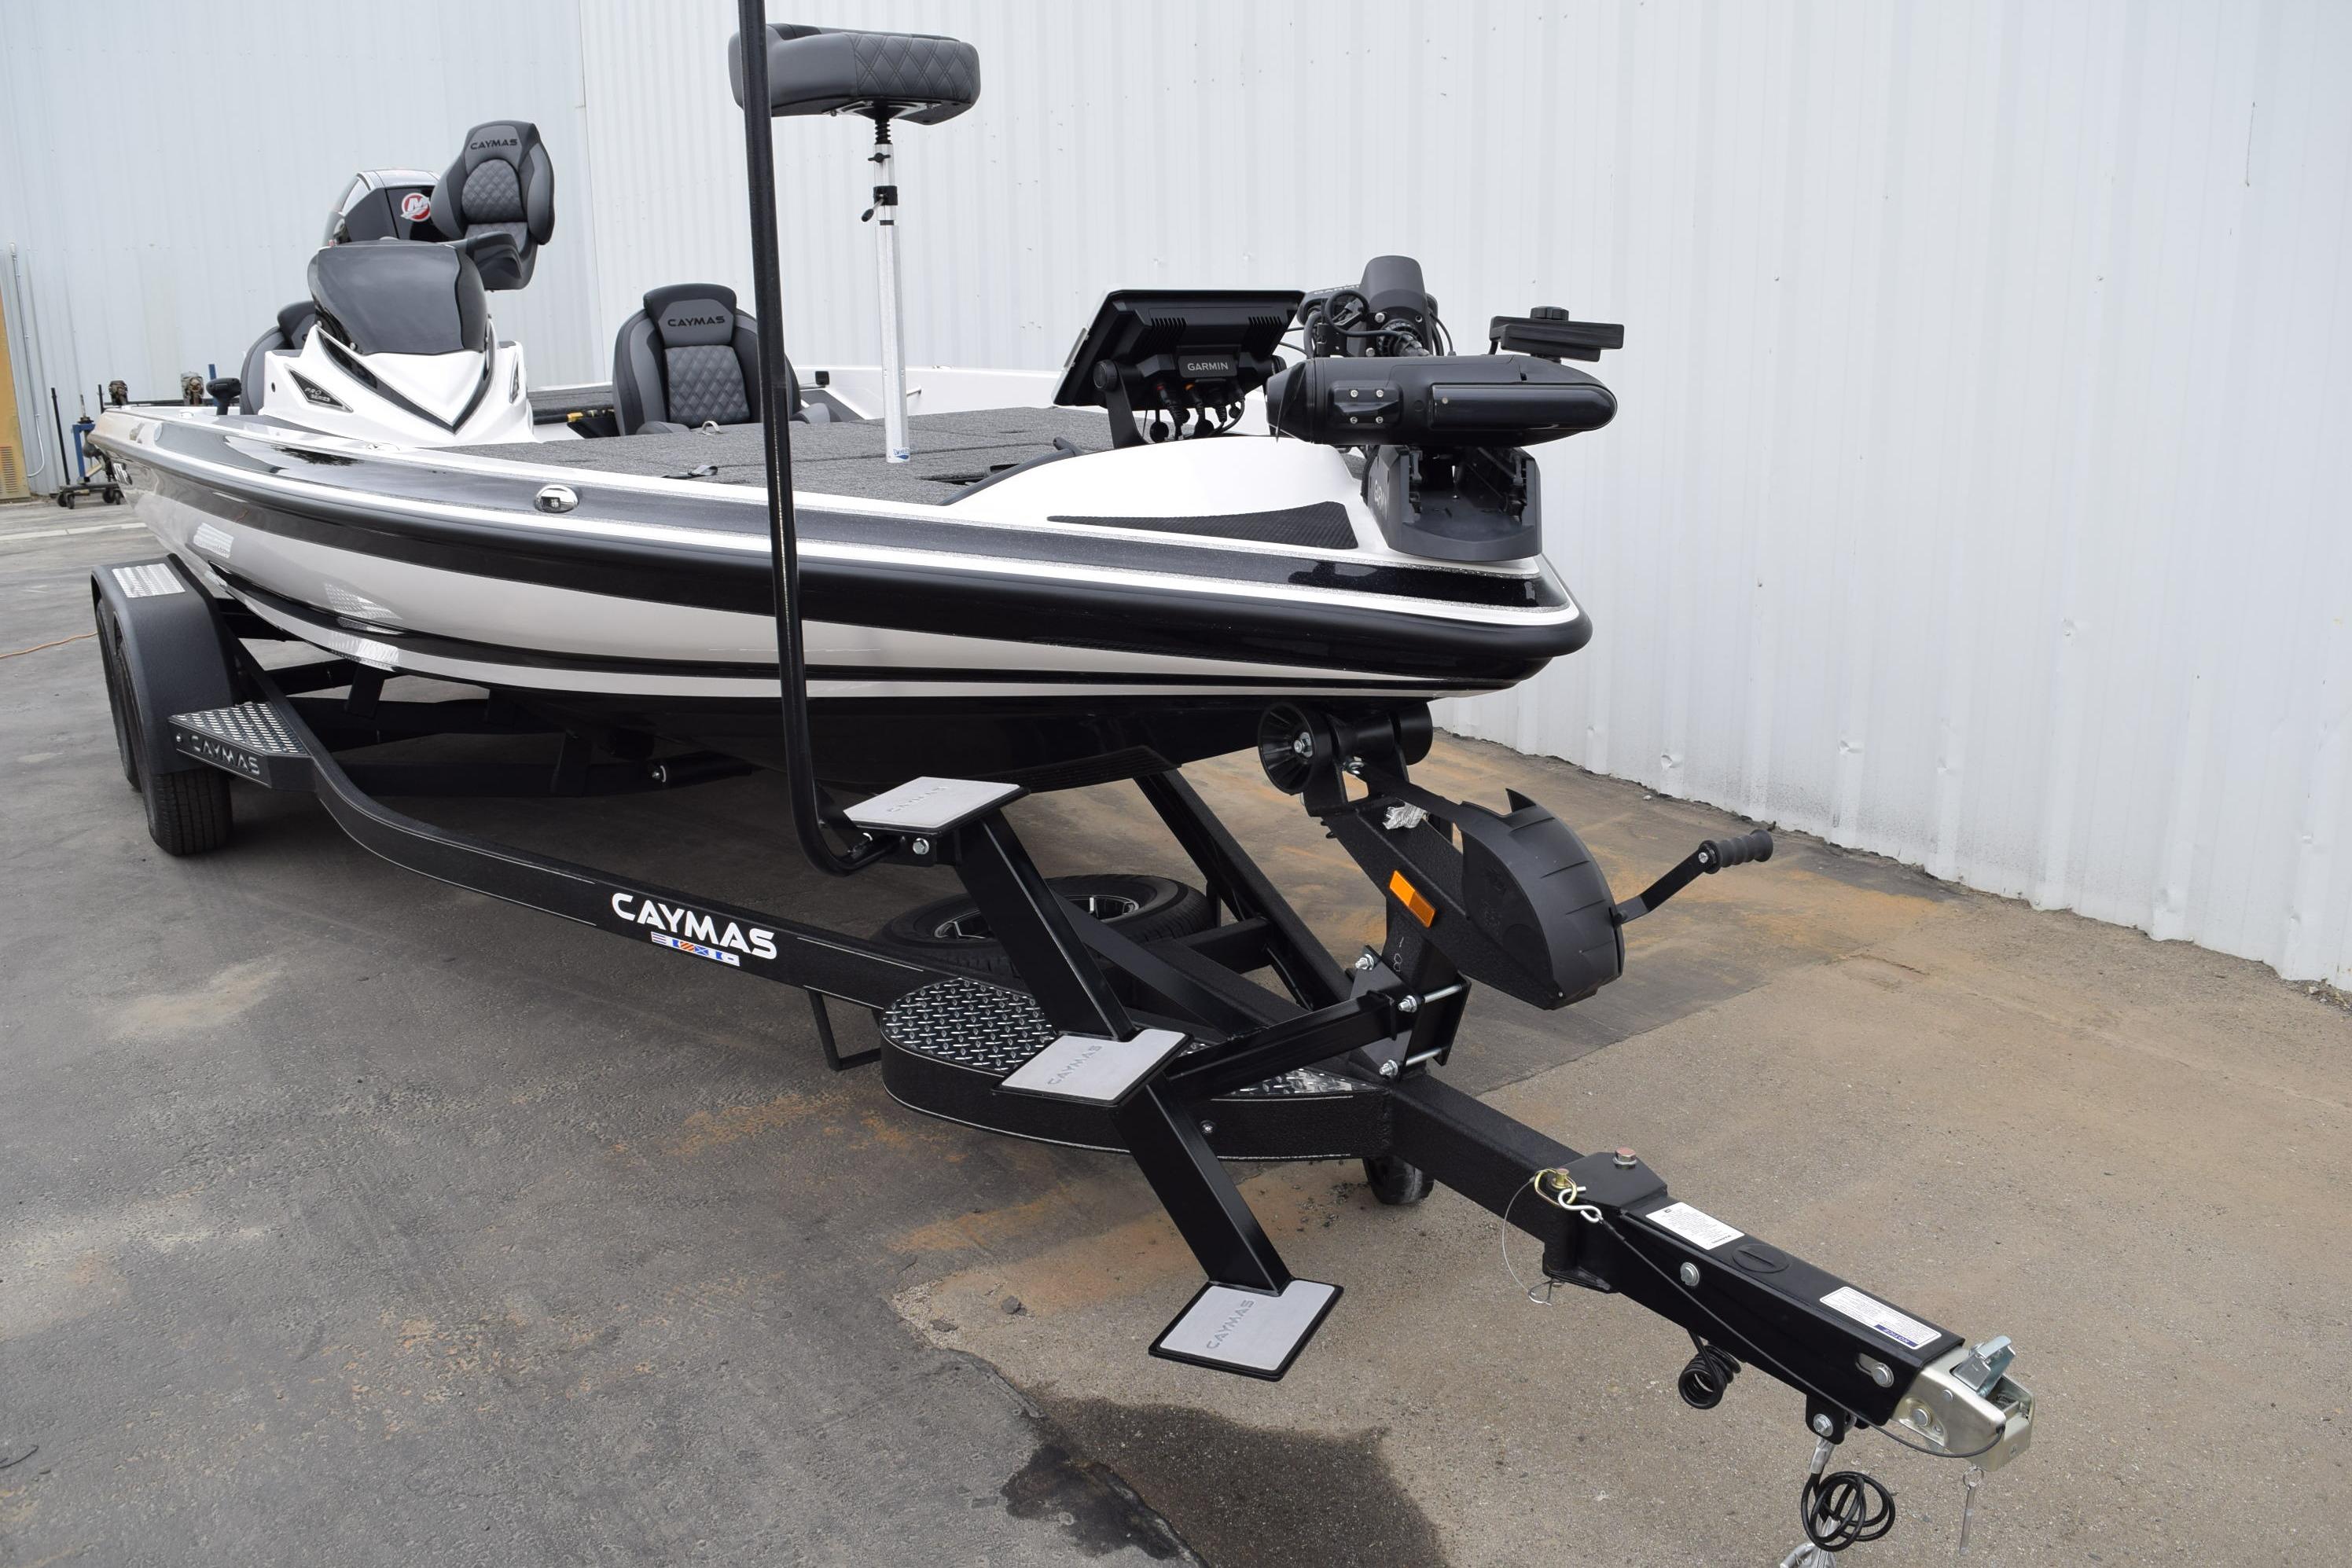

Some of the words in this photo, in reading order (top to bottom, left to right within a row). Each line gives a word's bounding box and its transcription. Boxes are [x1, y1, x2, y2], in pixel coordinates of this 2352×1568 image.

[470, 138, 518, 150] CAYMAS
[667, 316, 726, 327] CAYMAS
[1187, 362, 1229, 371] GARMIN
[190, 735, 260, 775] CAYMAS
[612, 892, 777, 960] CAYMAS
[1046, 1045, 1103, 1085] CAYMAS
[1206, 1299, 1255, 1350] CAYMAS
[1882, 1328, 1910, 1343] NOTICE
